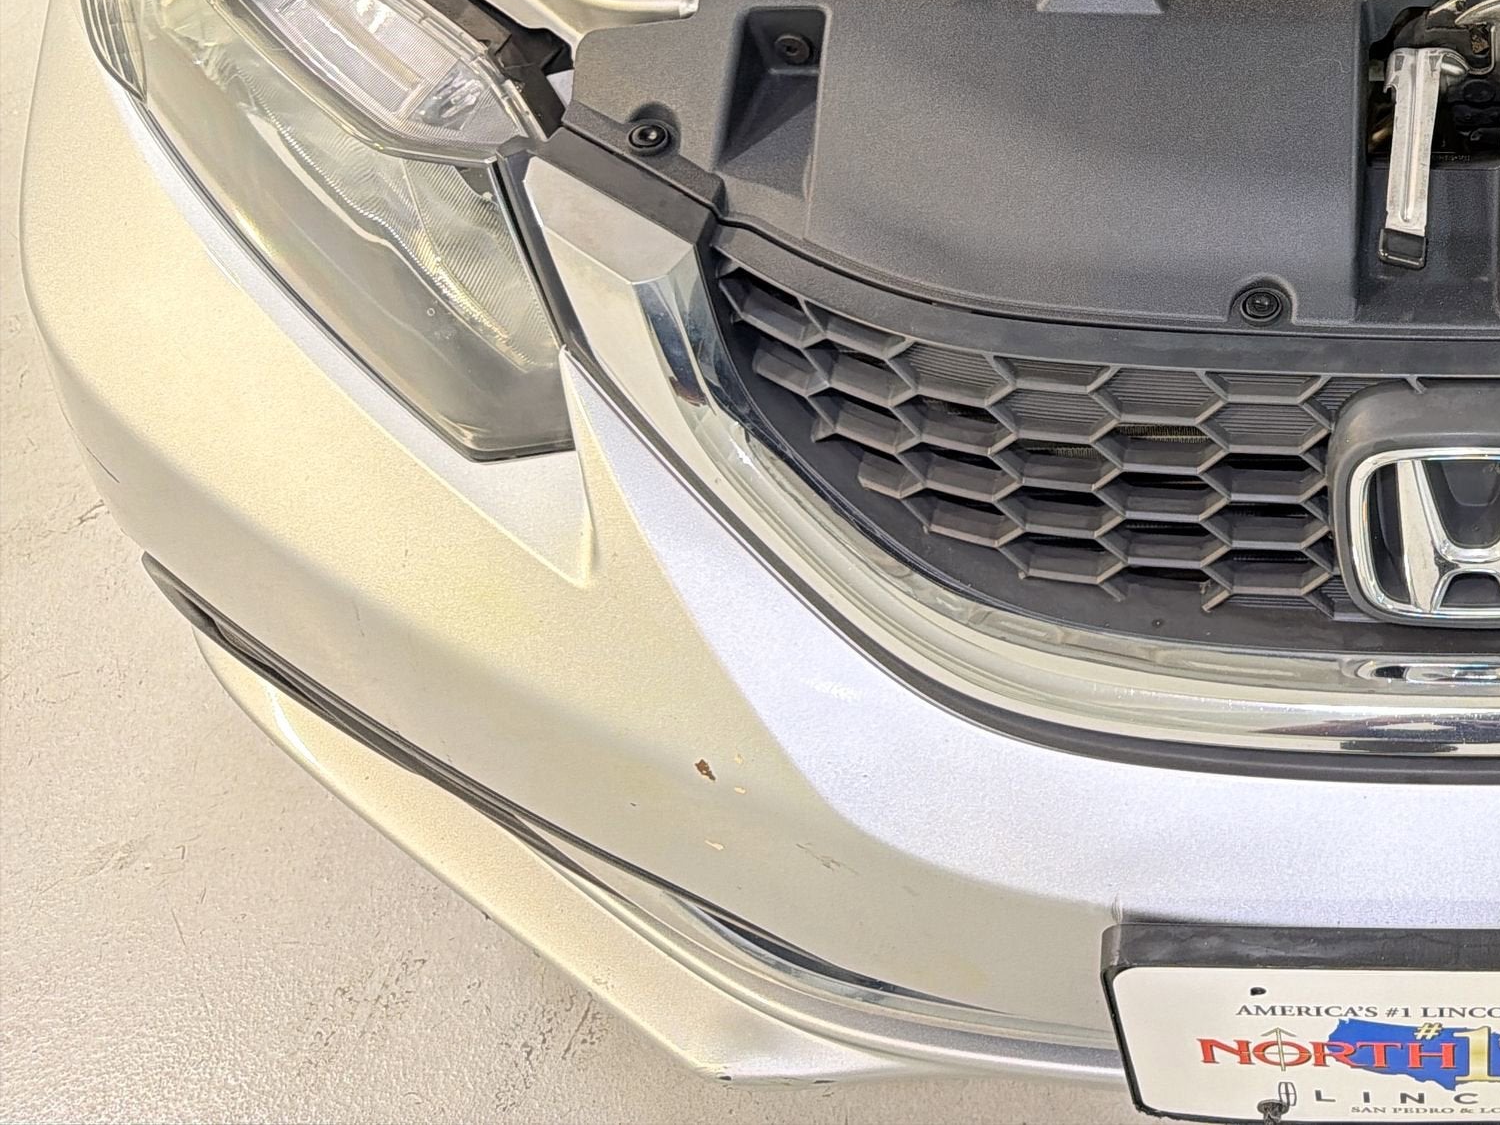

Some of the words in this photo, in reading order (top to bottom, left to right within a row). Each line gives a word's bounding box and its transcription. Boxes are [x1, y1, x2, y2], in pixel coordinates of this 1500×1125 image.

[1235, 1004, 1378, 1018] AMERICA'S
[1384, 1006, 1412, 1018] #1
[1197, 1038, 1458, 1070] NORTH
[1351, 1106, 1387, 1114] SAN
